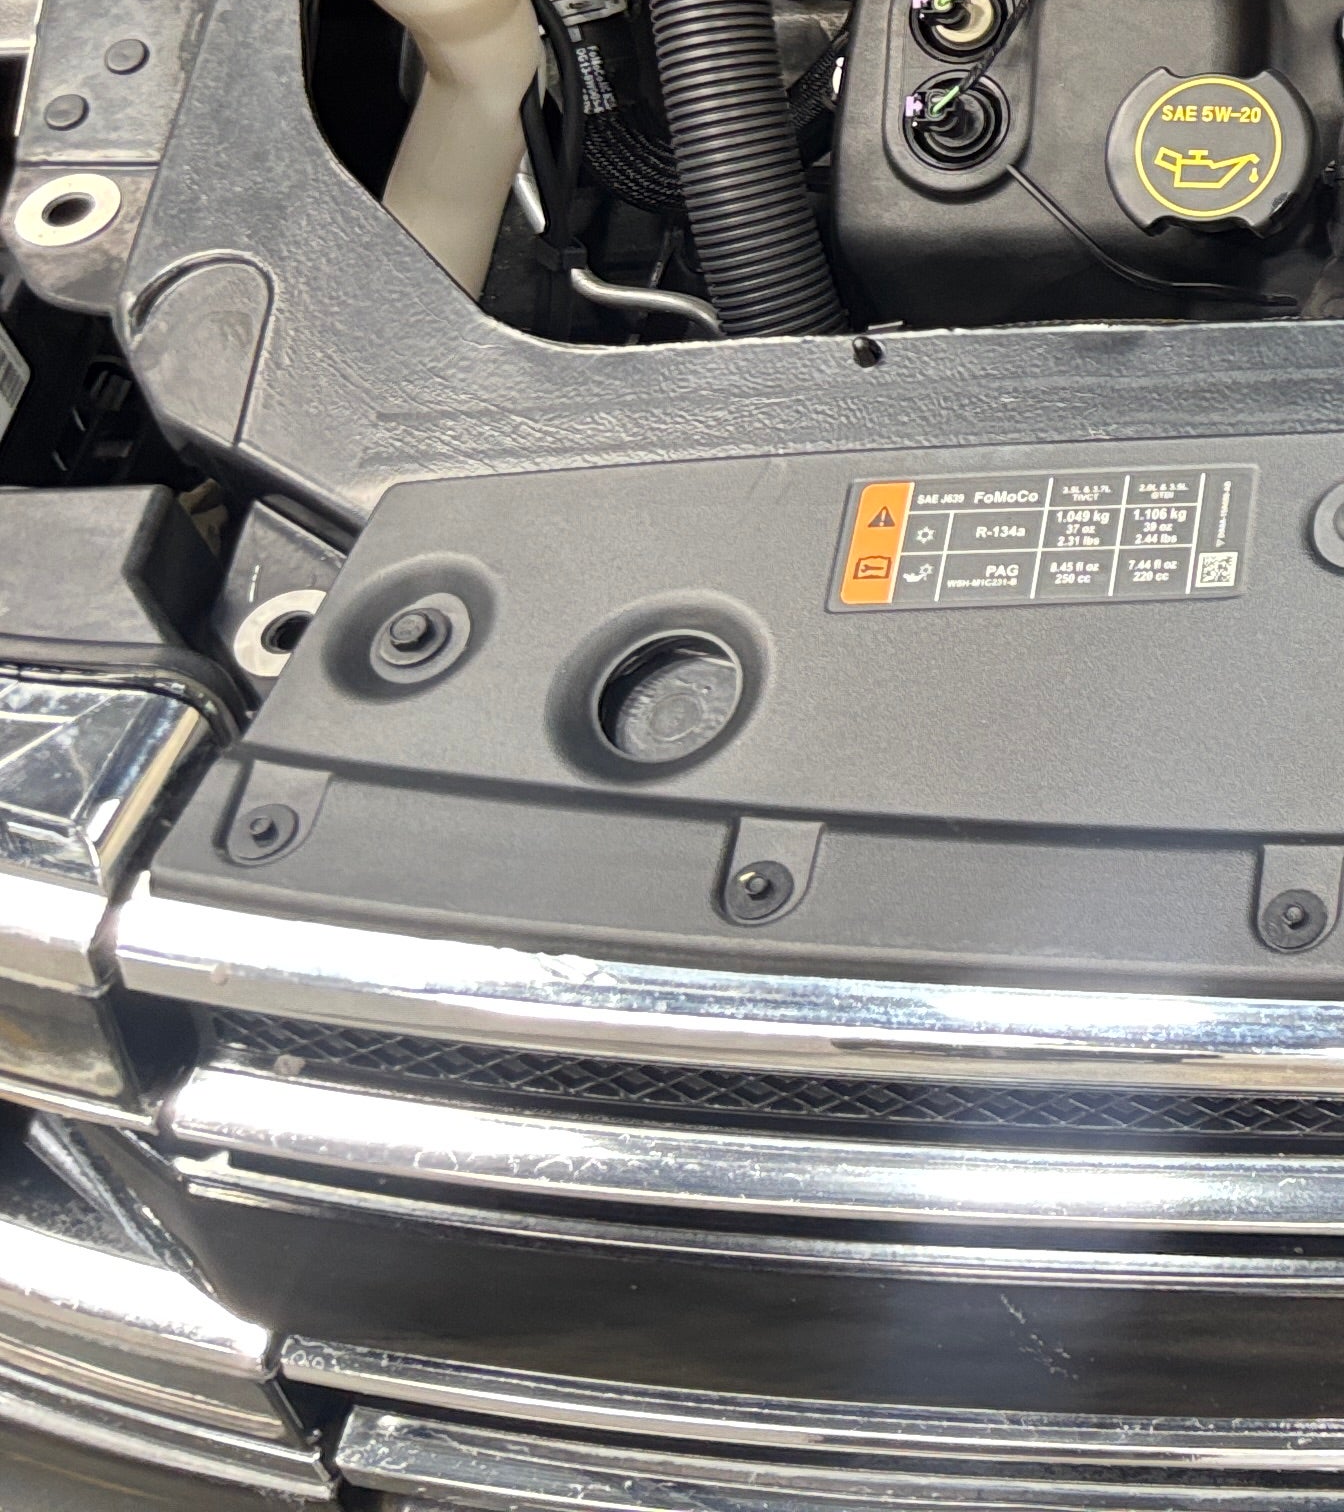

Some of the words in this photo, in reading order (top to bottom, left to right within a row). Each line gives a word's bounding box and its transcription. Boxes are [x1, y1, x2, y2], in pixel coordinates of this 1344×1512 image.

[1161, 105, 1198, 122] SAE
[1201, 105, 1262, 123] 5W-20
[917, 494, 939, 505] SAE
[973, 490, 1039, 504] FoMoCo
[1056, 510, 1091, 524] 1.049
[1092, 510, 1110, 525] kg
[1133, 508, 1168, 521] 1.106
[1169, 507, 1187, 523] kg
[975, 525, 1026, 539] R-134a
[1065, 523, 1080, 535] 37
[1081, 525, 1096, 534] oz
[1158, 523, 1173, 532] oz
[1057, 535, 1081, 547] 2.31
[1082, 535, 1100, 546] lbs
[1160, 532, 1178, 544] lbs
[985, 564, 1019, 577] PAG
[1085, 563, 1100, 573] oz
[1163, 560, 1178, 571] oz
[1077, 574, 1092, 584] cc
[1155, 572, 1170, 581] cc
